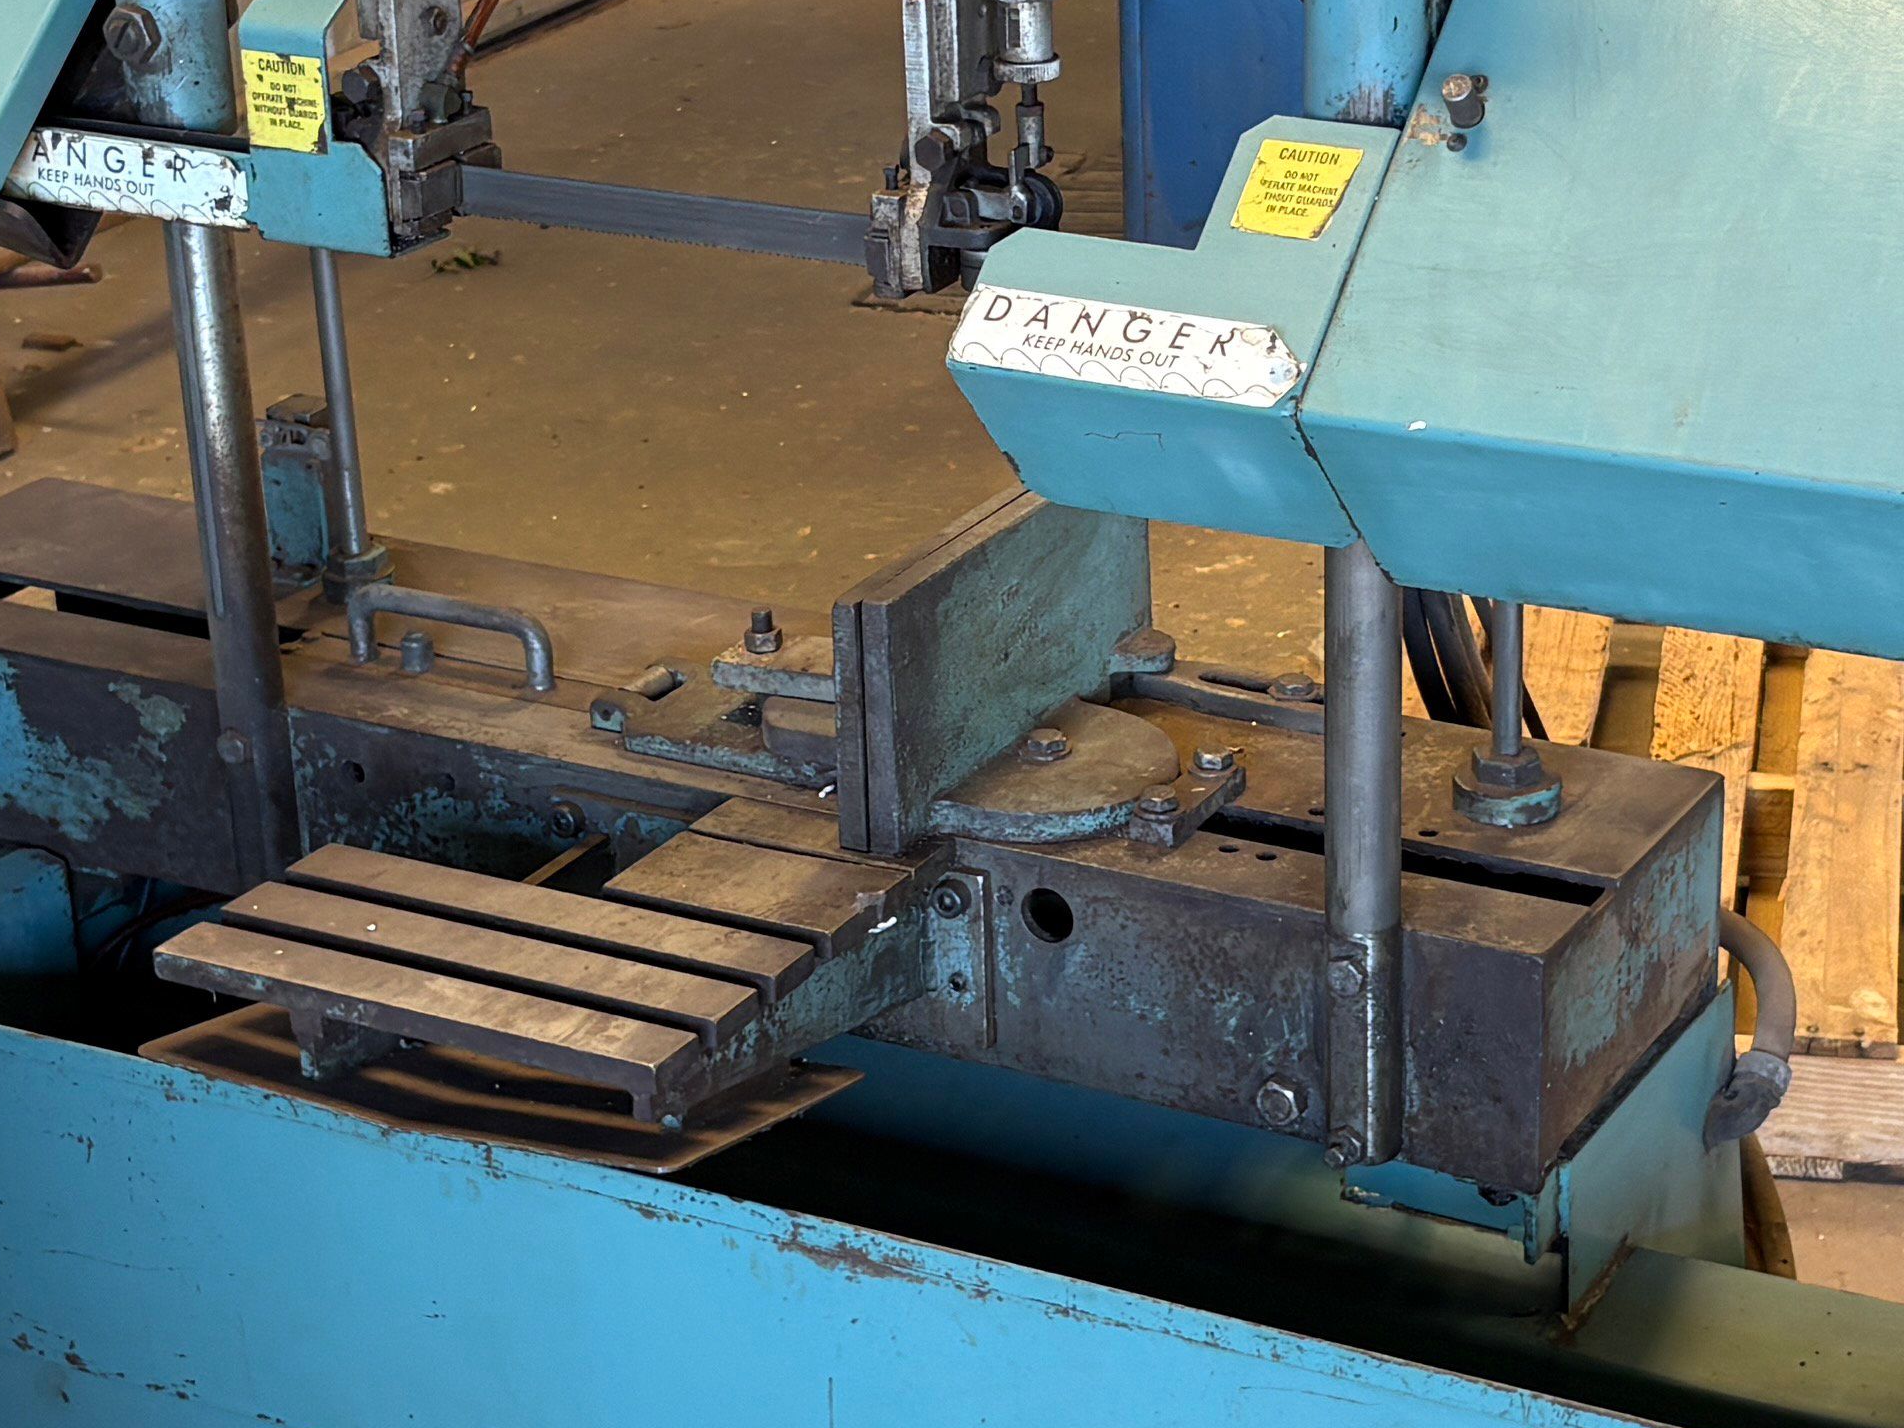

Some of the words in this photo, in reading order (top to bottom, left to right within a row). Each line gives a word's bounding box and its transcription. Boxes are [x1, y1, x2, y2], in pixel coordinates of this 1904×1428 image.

[258, 58, 305, 76] CAUTION
[270, 82, 281, 91] DO
[32, 133, 187, 183] ANGER
[1279, 148, 1340, 165] CAUTION
[38, 166, 70, 186] KEEP
[74, 173, 121, 192] HANDS
[126, 179, 155, 196] OUT
[1284, 170, 1298, 179] DO
[1299, 172, 1319, 182] NOT
[1266, 204, 1276, 213] IN
[984, 294, 1235, 357] DANGER
[1022, 333, 1066, 351] KEEP
[1069, 340, 1131, 362] HANDS
[1138, 350, 1180, 369] OUT
